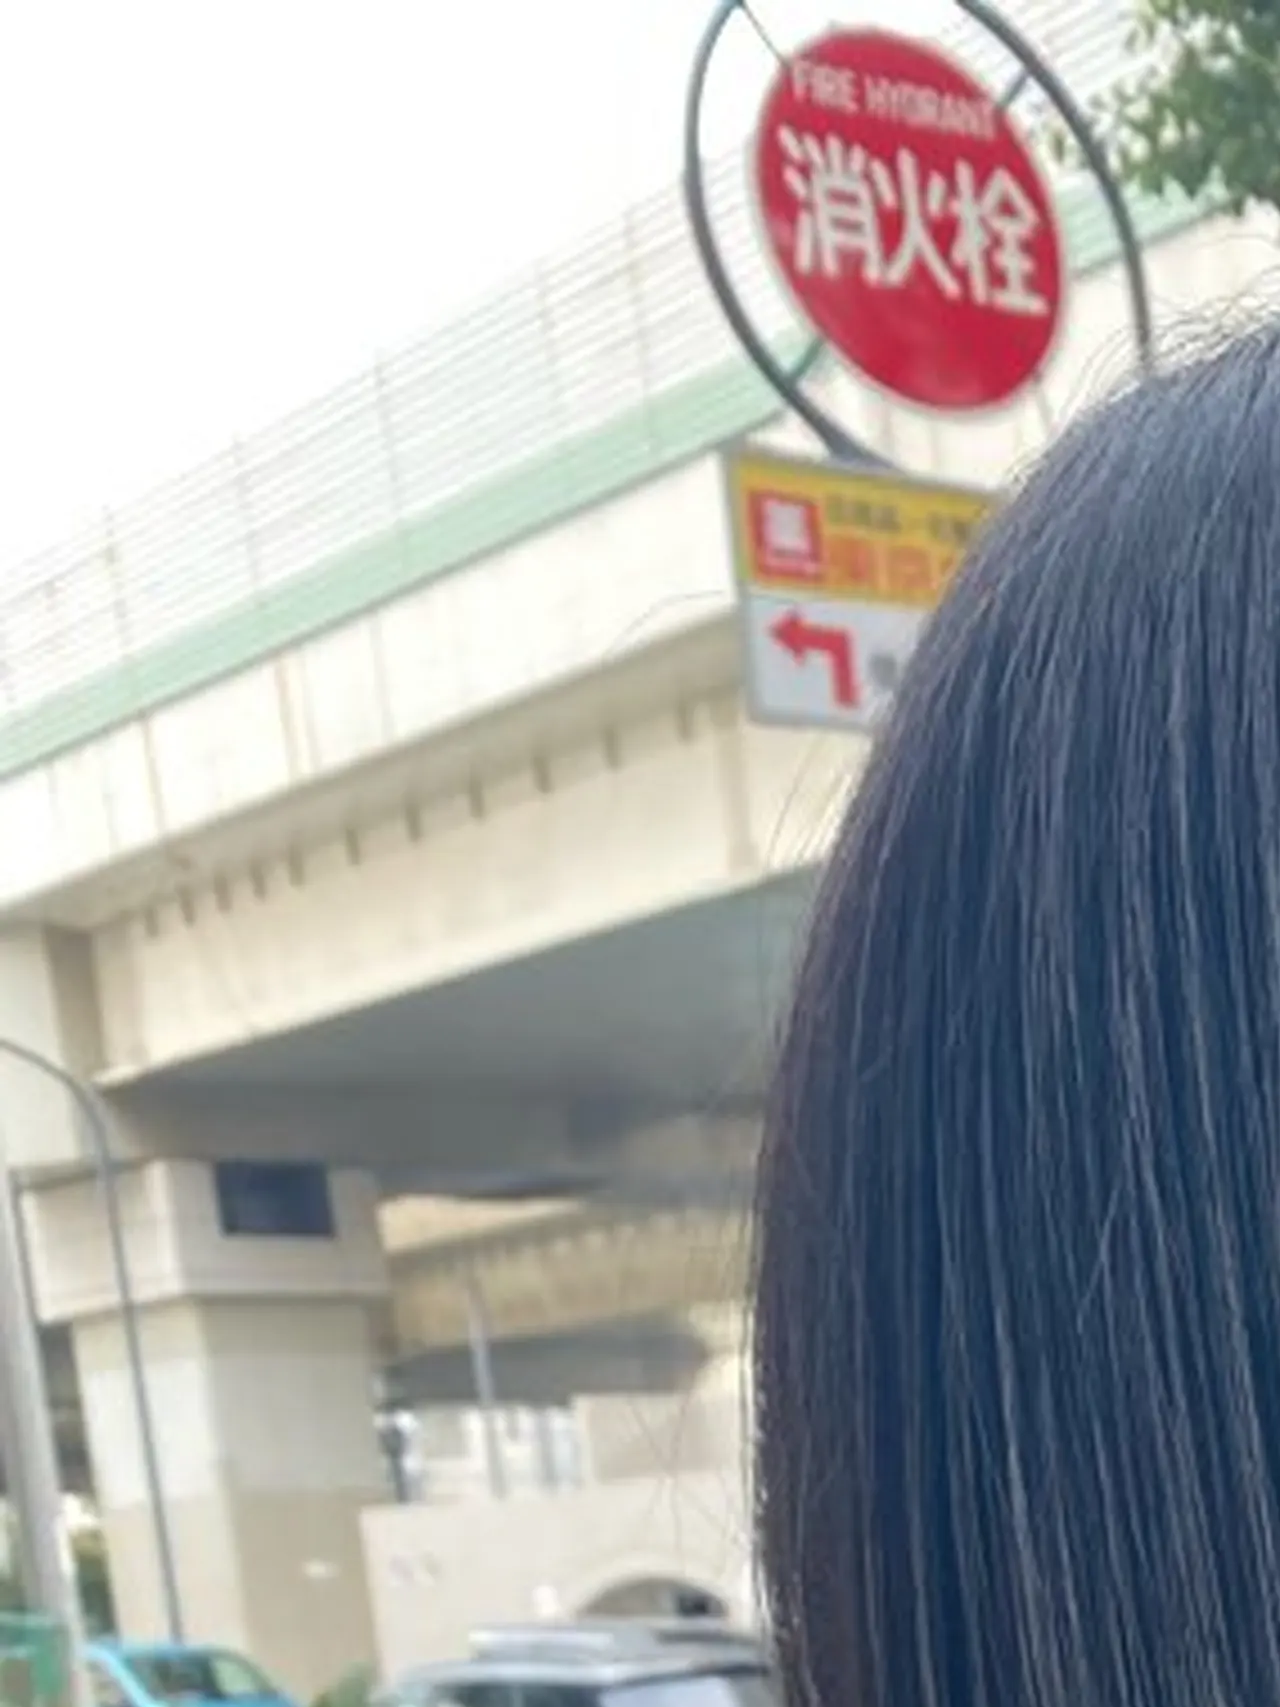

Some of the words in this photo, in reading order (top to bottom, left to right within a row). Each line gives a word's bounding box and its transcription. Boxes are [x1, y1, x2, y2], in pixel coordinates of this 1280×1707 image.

[792, 60, 859, 114] FIRE
[863, 73, 996, 139] HYDRANT
[777, 124, 1048, 314] 消火栓
